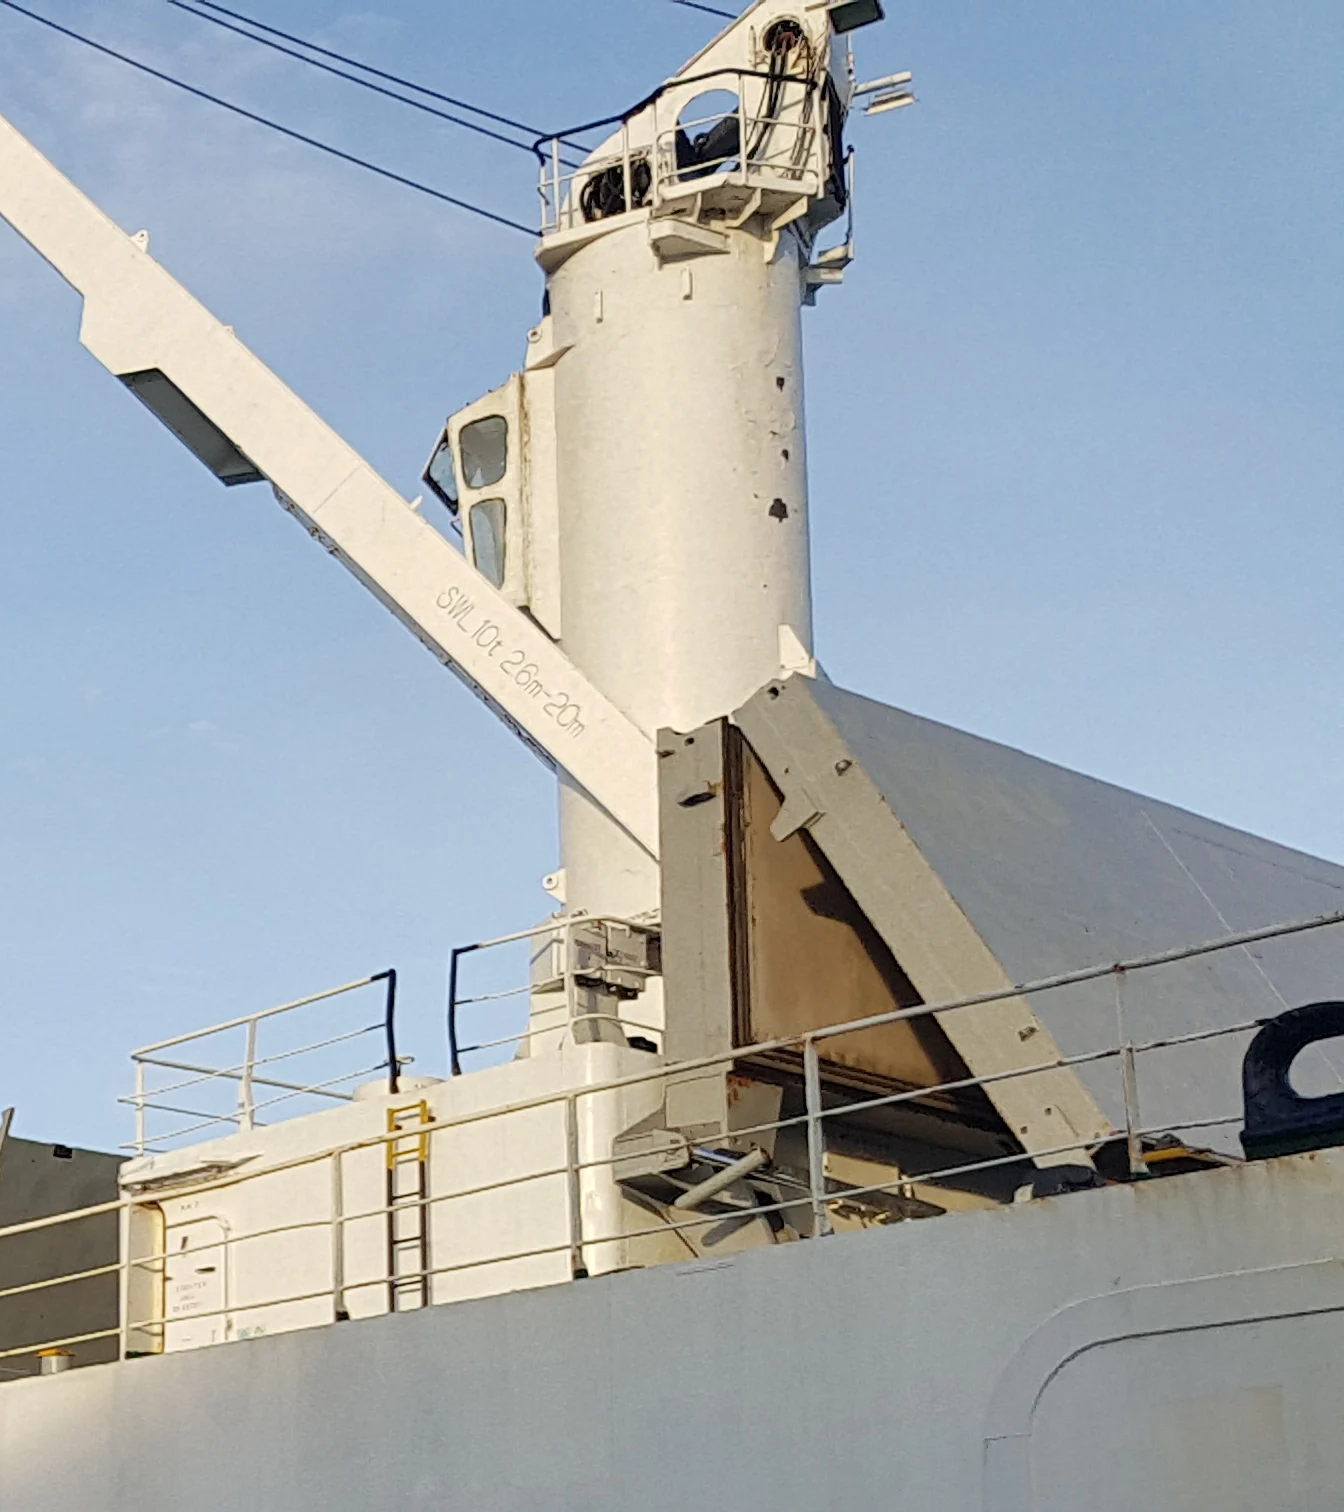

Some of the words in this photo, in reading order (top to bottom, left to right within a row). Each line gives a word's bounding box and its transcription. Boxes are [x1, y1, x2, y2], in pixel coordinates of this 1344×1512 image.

[435, 585, 475, 633] SWL
[471, 618, 505, 657] 10t
[499, 649, 586, 739] 26m-20m
